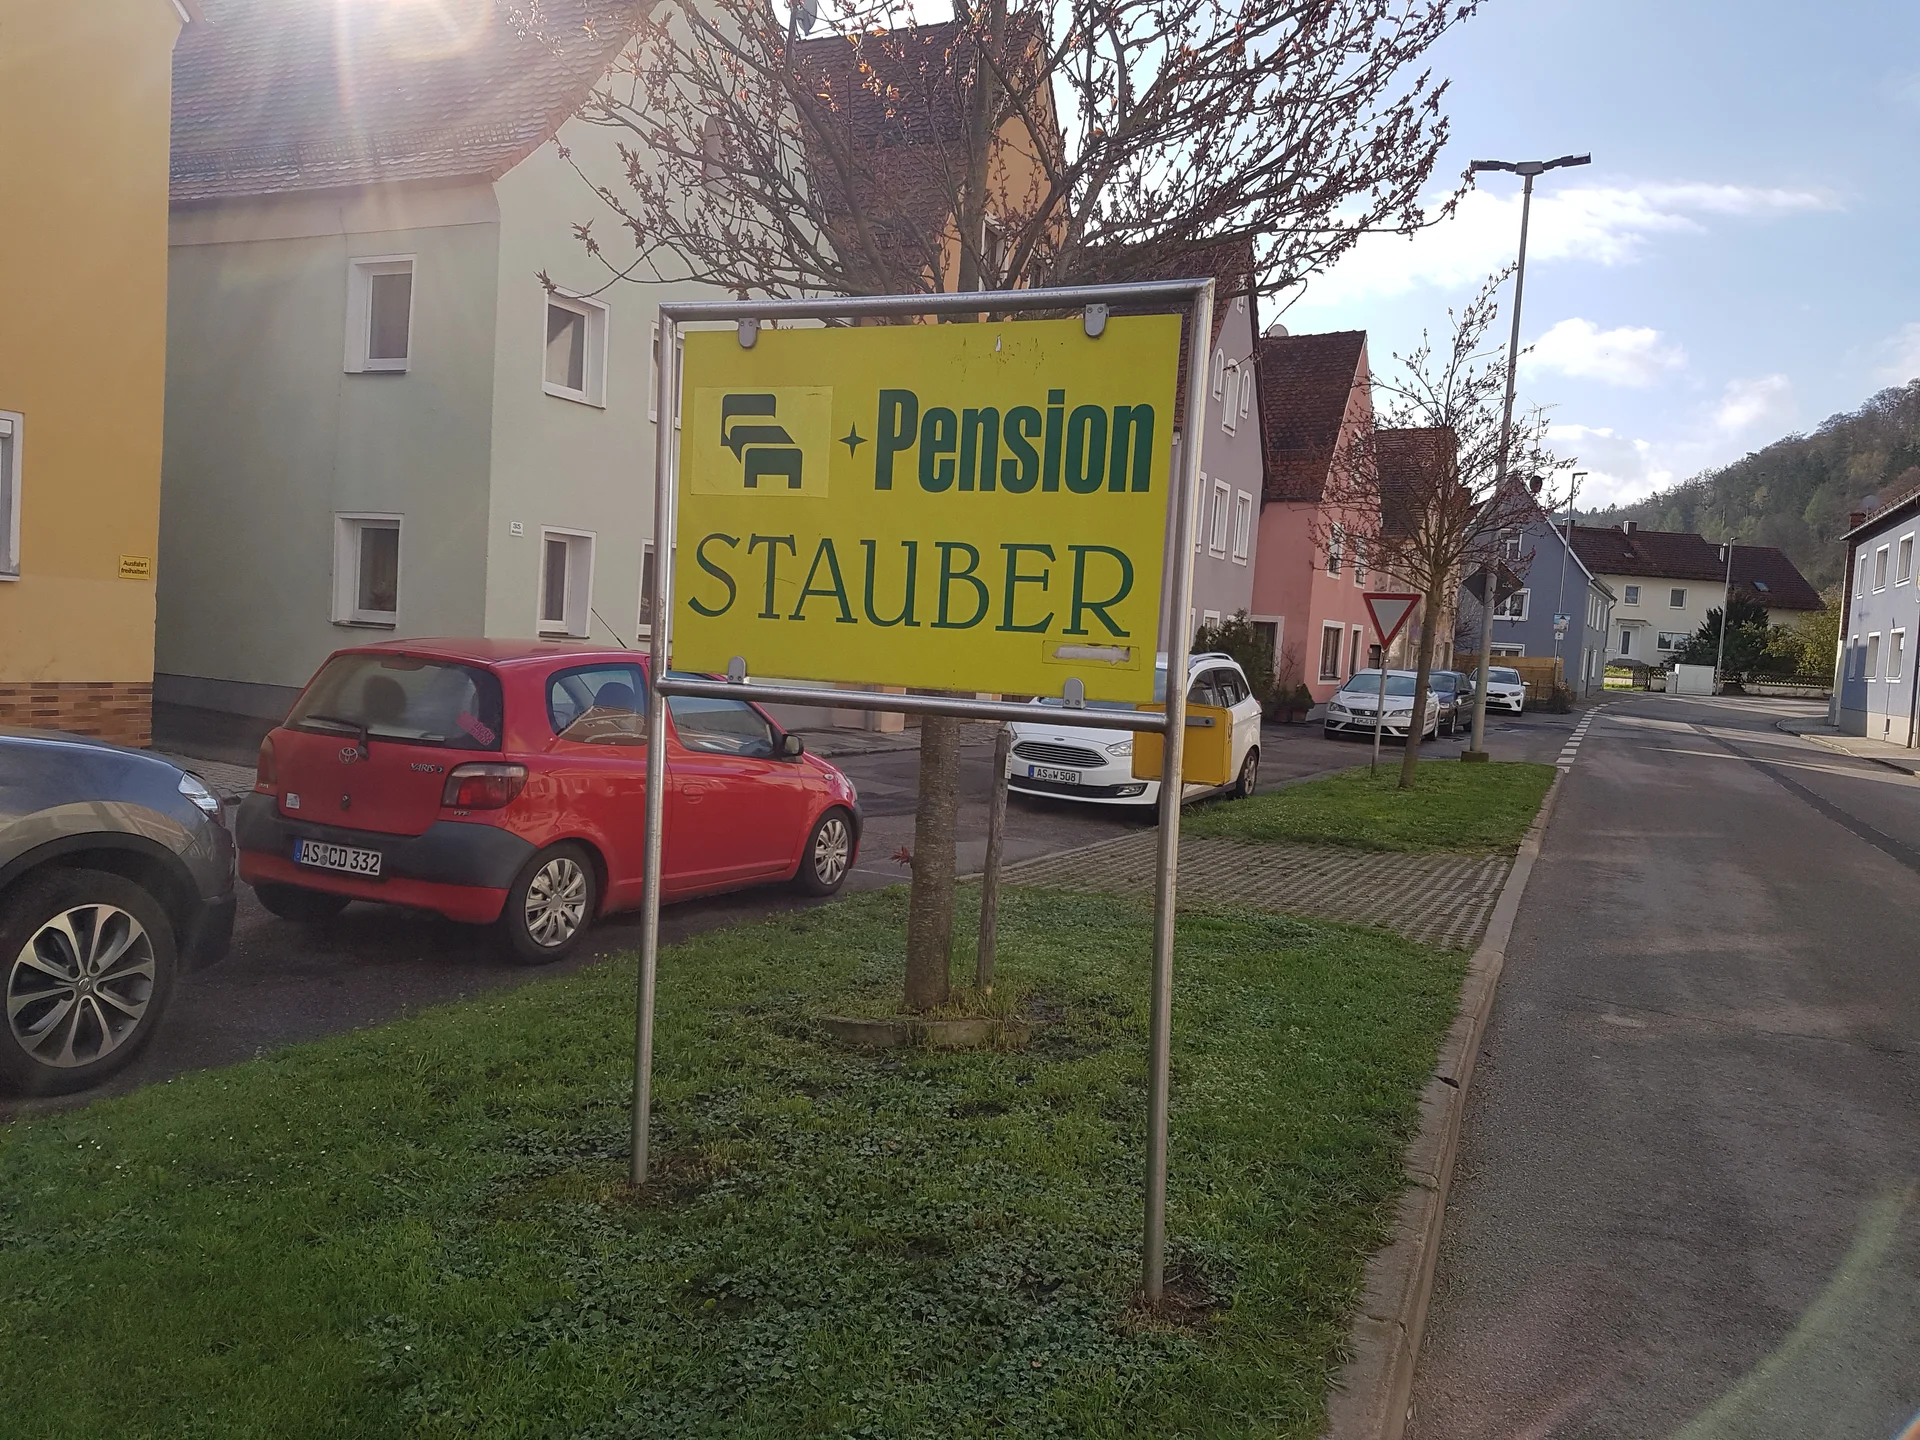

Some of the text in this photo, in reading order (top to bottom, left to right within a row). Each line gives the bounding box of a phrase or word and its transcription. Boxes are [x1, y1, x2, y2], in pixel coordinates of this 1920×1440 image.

[874, 388, 1156, 494] Pension
[687, 532, 1135, 638] STAUBER
[302, 843, 380, 873] AS CD 332
